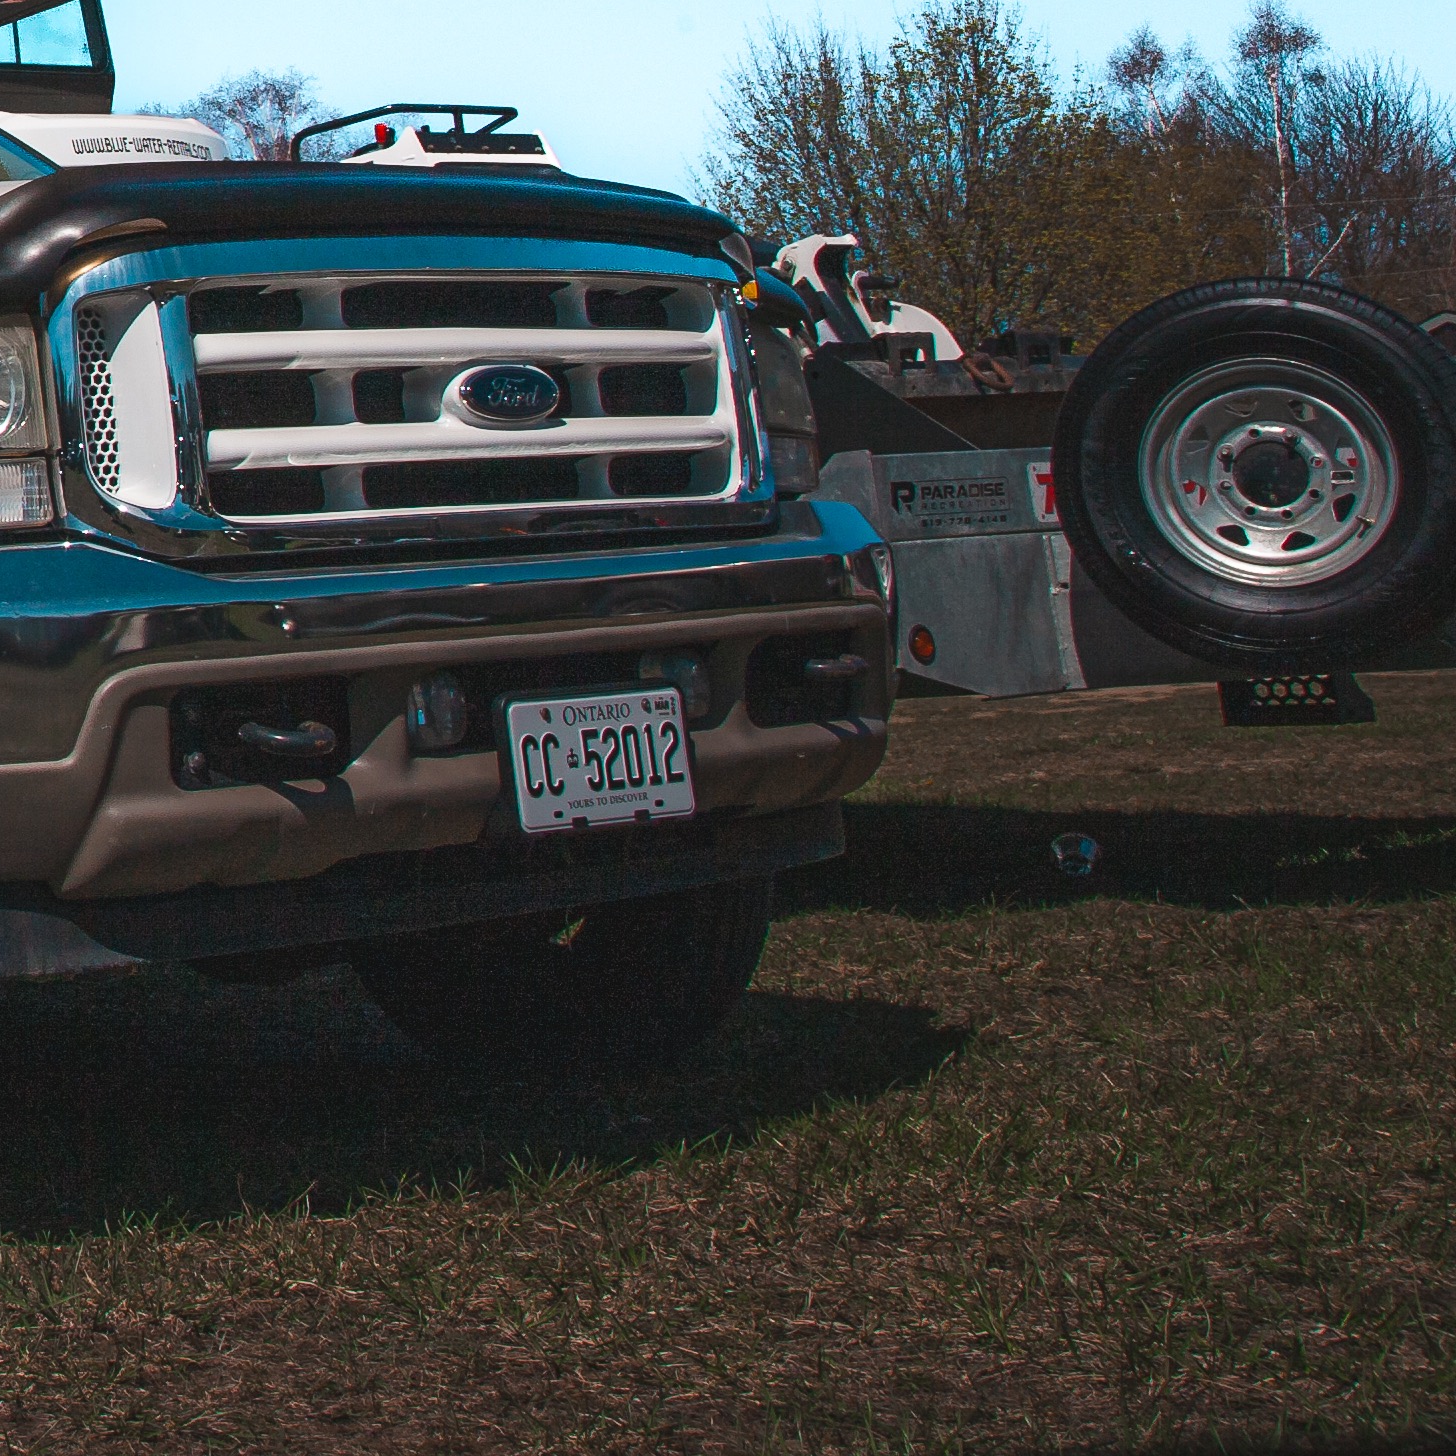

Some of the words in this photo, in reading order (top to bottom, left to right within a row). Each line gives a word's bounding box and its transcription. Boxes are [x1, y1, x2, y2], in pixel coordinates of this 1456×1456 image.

[488, 377, 540, 408] Ford
[920, 482, 1006, 500] PARADISE
[562, 702, 630, 726] ONTARIO
[521, 732, 565, 798] CC
[580, 720, 685, 792] 52012
[568, 798, 595, 809] YOURS
[596, 796, 608, 806] TO
[609, 792, 649, 804] DISCOVER
